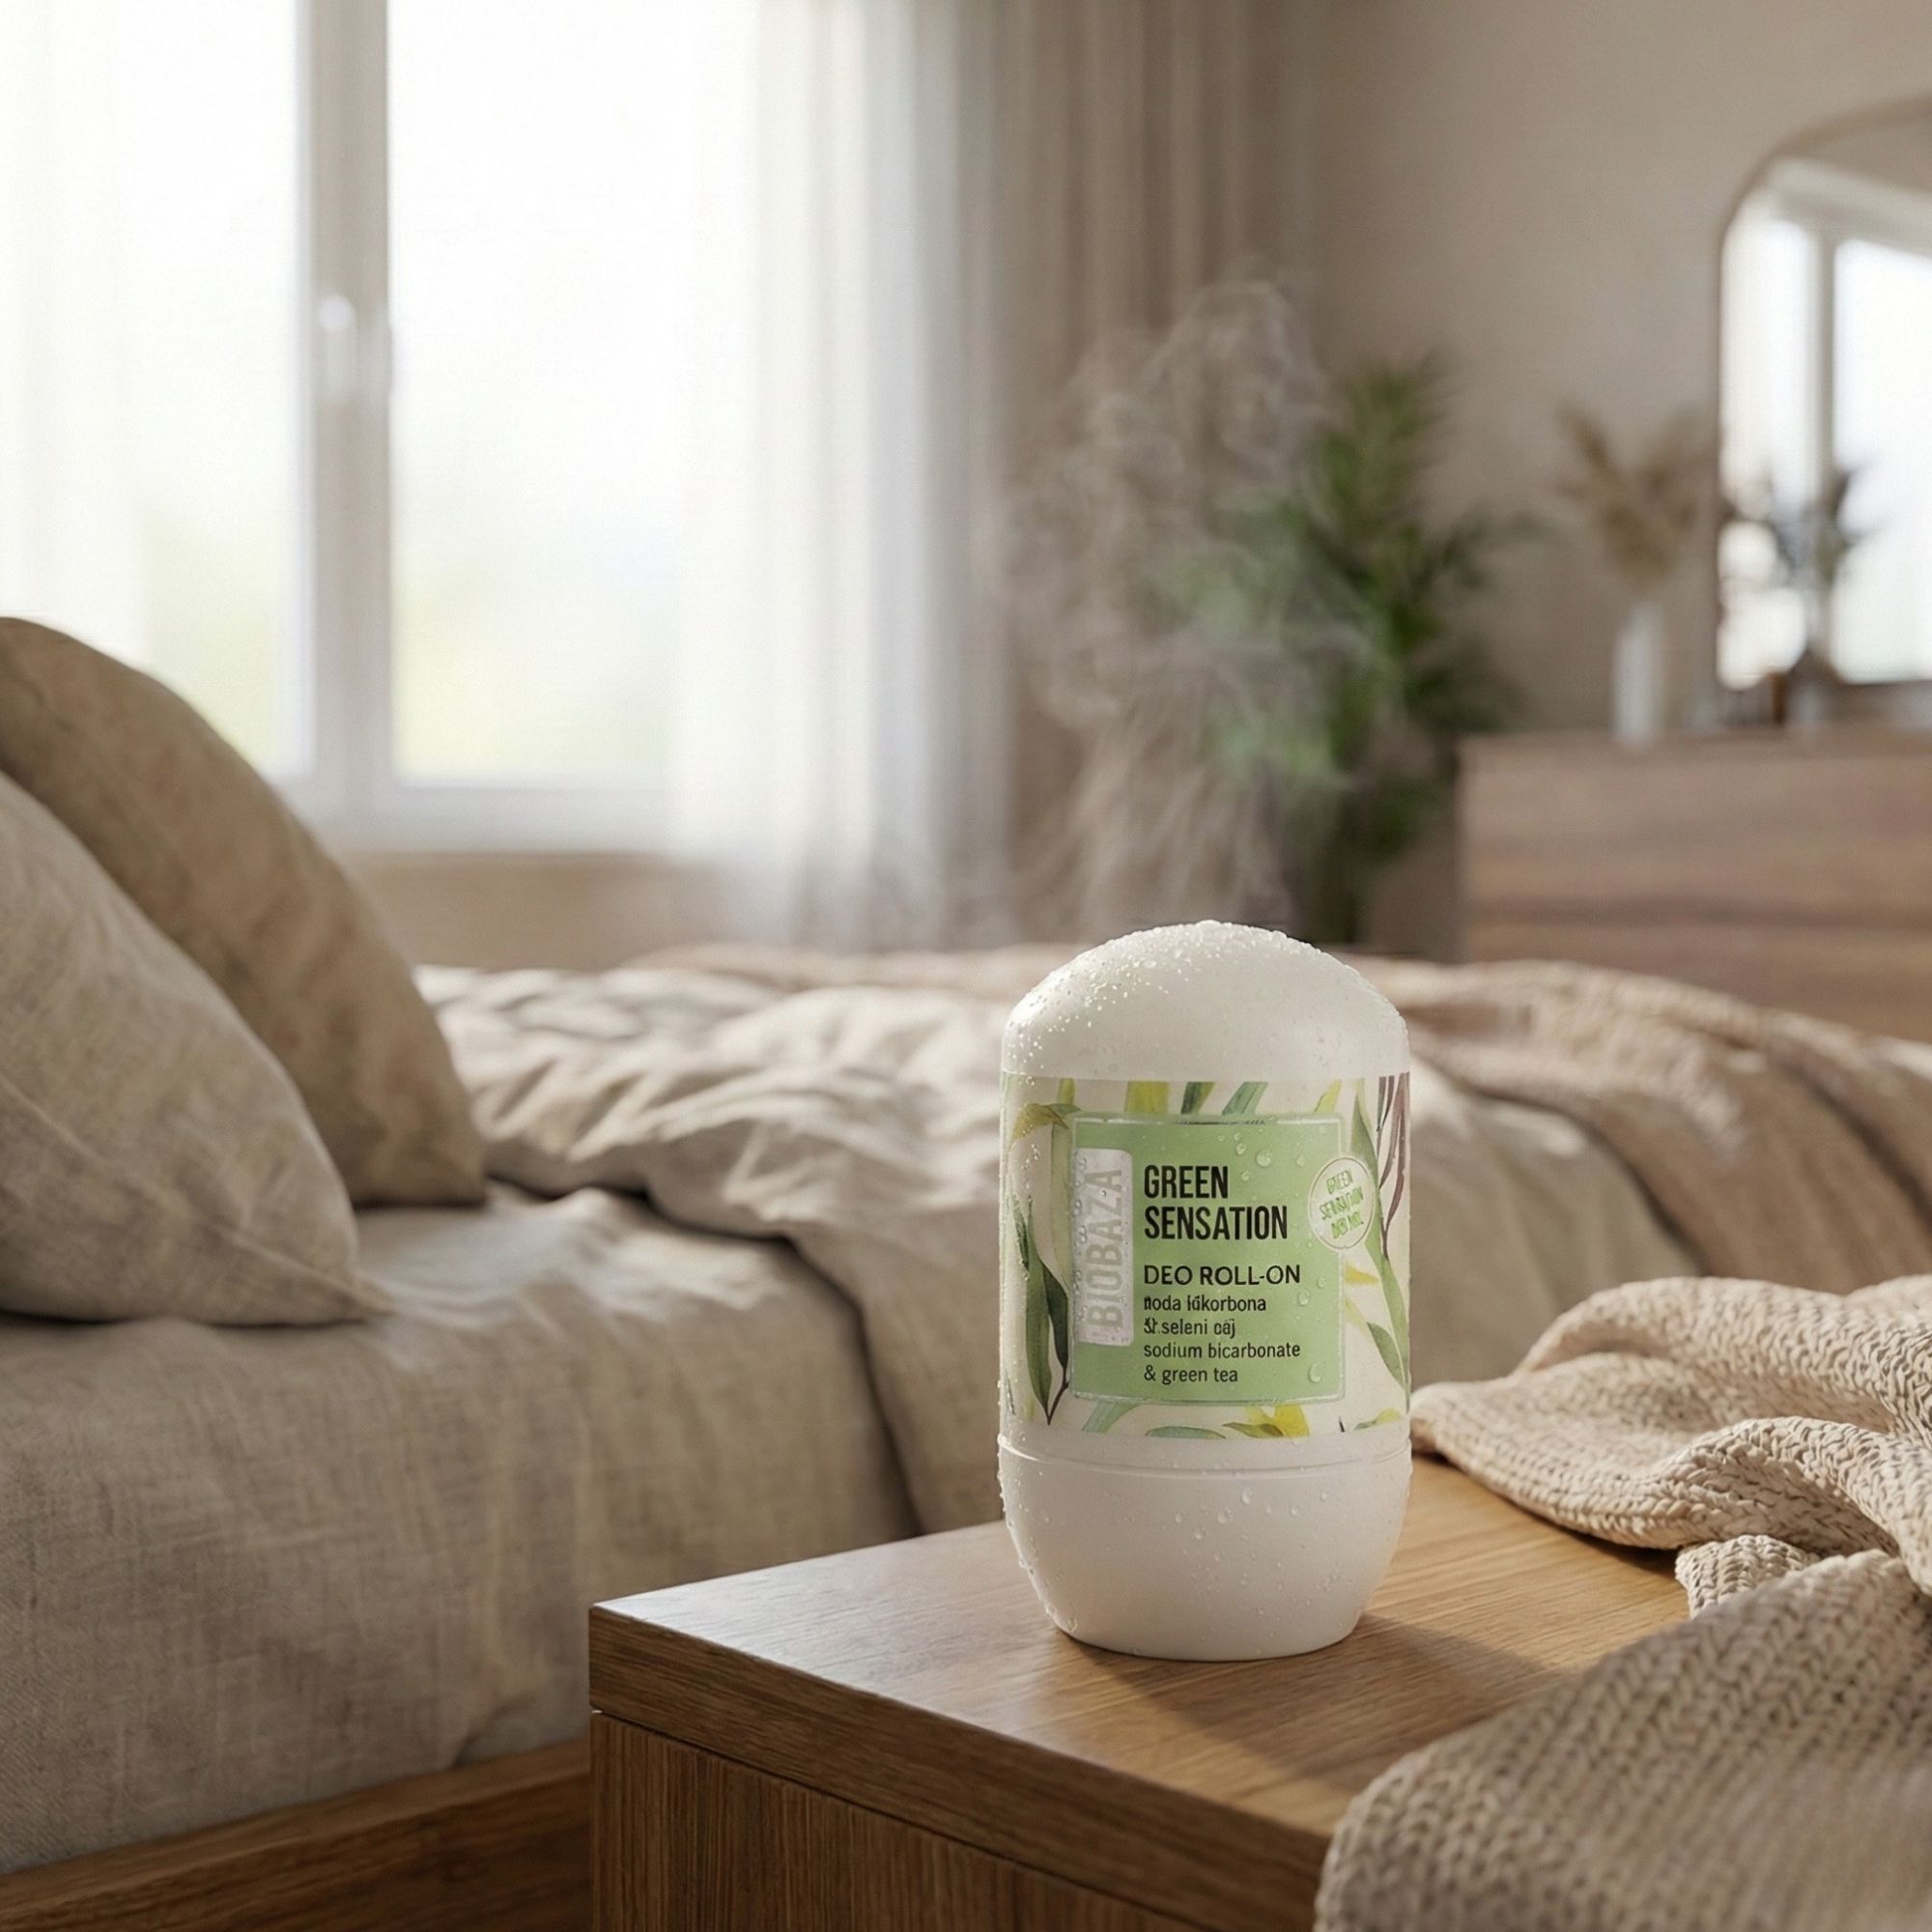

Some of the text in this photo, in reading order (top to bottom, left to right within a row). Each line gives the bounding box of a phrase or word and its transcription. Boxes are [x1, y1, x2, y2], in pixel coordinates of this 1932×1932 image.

[1144, 1165, 1228, 1199] GREEN
[1144, 1206, 1288, 1239] SENSATION
[1084, 1170, 1122, 1327] BIOBAZA
[1144, 1264, 1300, 1285] DEO ROLL-ON
[1144, 1342, 1300, 1358] sodium bicarbonate
[1144, 1364, 1237, 1385] & green tea
